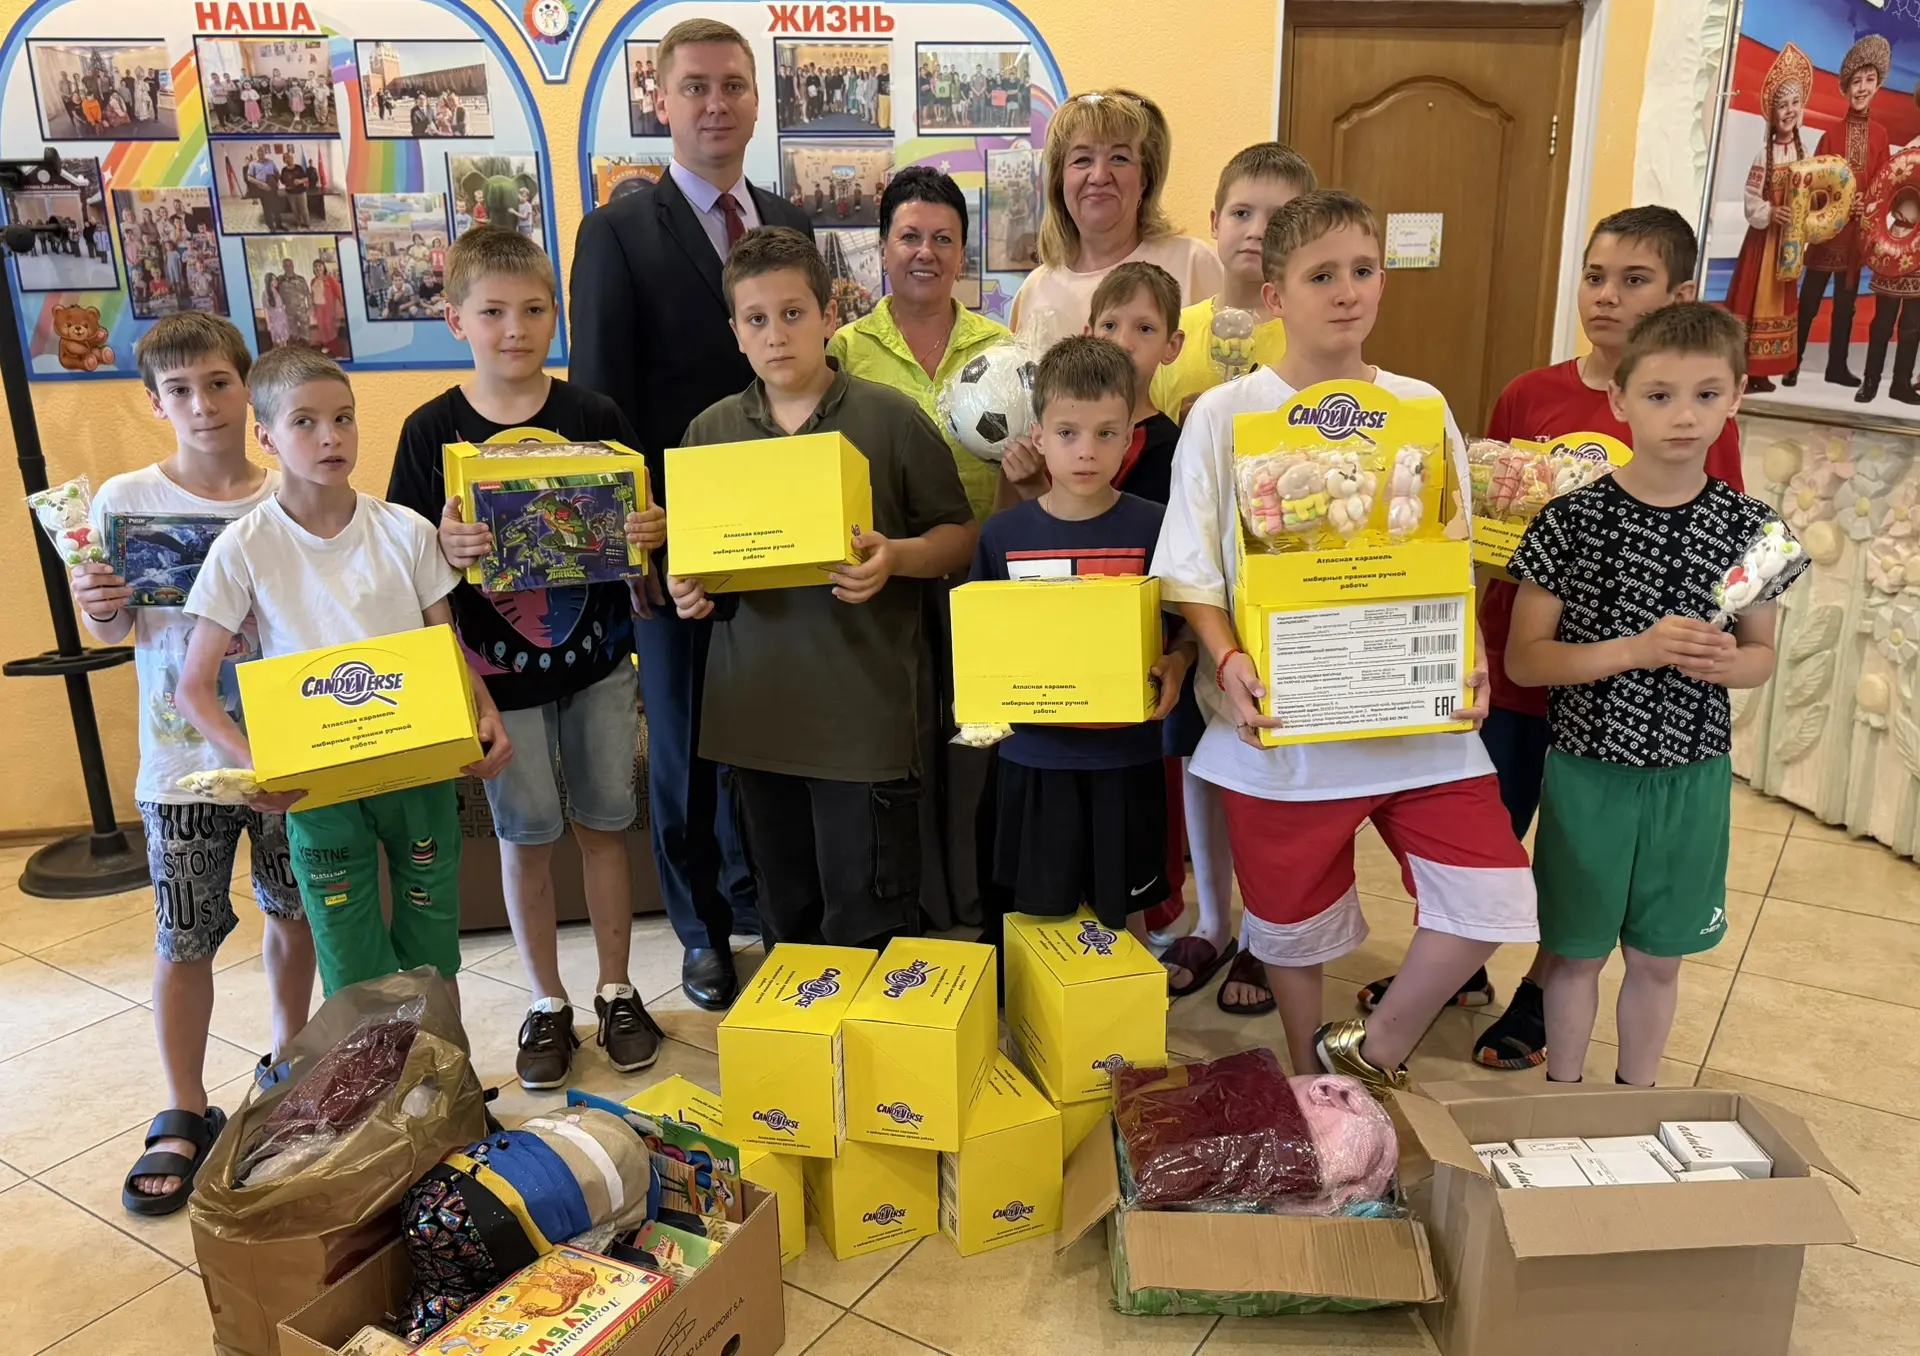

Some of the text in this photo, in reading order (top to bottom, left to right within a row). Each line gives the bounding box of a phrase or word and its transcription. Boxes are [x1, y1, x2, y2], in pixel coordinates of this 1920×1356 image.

[195, 2, 316, 30] НАША
[767, 5, 895, 32] ЖИЗНЬ
[1739, 505, 1765, 524] Supr
[753, 528, 783, 536] карамель
[1482, 525, 1513, 536] Атласная
[1545, 507, 1570, 552] Supreme
[1618, 518, 1667, 546] Supreme
[1685, 521, 1732, 554] Supreme
[745, 545, 771, 553] пряники
[772, 543, 795, 551] ручной
[1317, 554, 1392, 564] Атласная карамель
[1527, 531, 1556, 574] Supreme
[1618, 545, 1667, 575] Supreme
[1303, 570, 1406, 583] имбирные пряники ручной
[1615, 570, 1662, 599] Supreme
[1565, 600, 1599, 620] preme
[1563, 619, 1600, 642] upreme
[1663, 672, 1703, 699] Supreme
[1002, 699, 1035, 707] имбирные
[1064, 699, 1089, 707] ручной
[1033, 707, 1057, 715] работы
[1607, 690, 1652, 720] Supreme
[1661, 696, 1695, 721] Supreme
[322, 711, 395, 730] Атласная карамель
[1602, 712, 1647, 744] Supreme
[1660, 719, 1692, 743] Supreme
[311, 723, 412, 749] имбирные пряники ручной
[350, 740, 377, 750] работы
[1602, 735, 1645, 767] Supreme
[624, 1284, 670, 1334] КУБИКИ
[695, 1309, 733, 1351] LEVEXPORT
